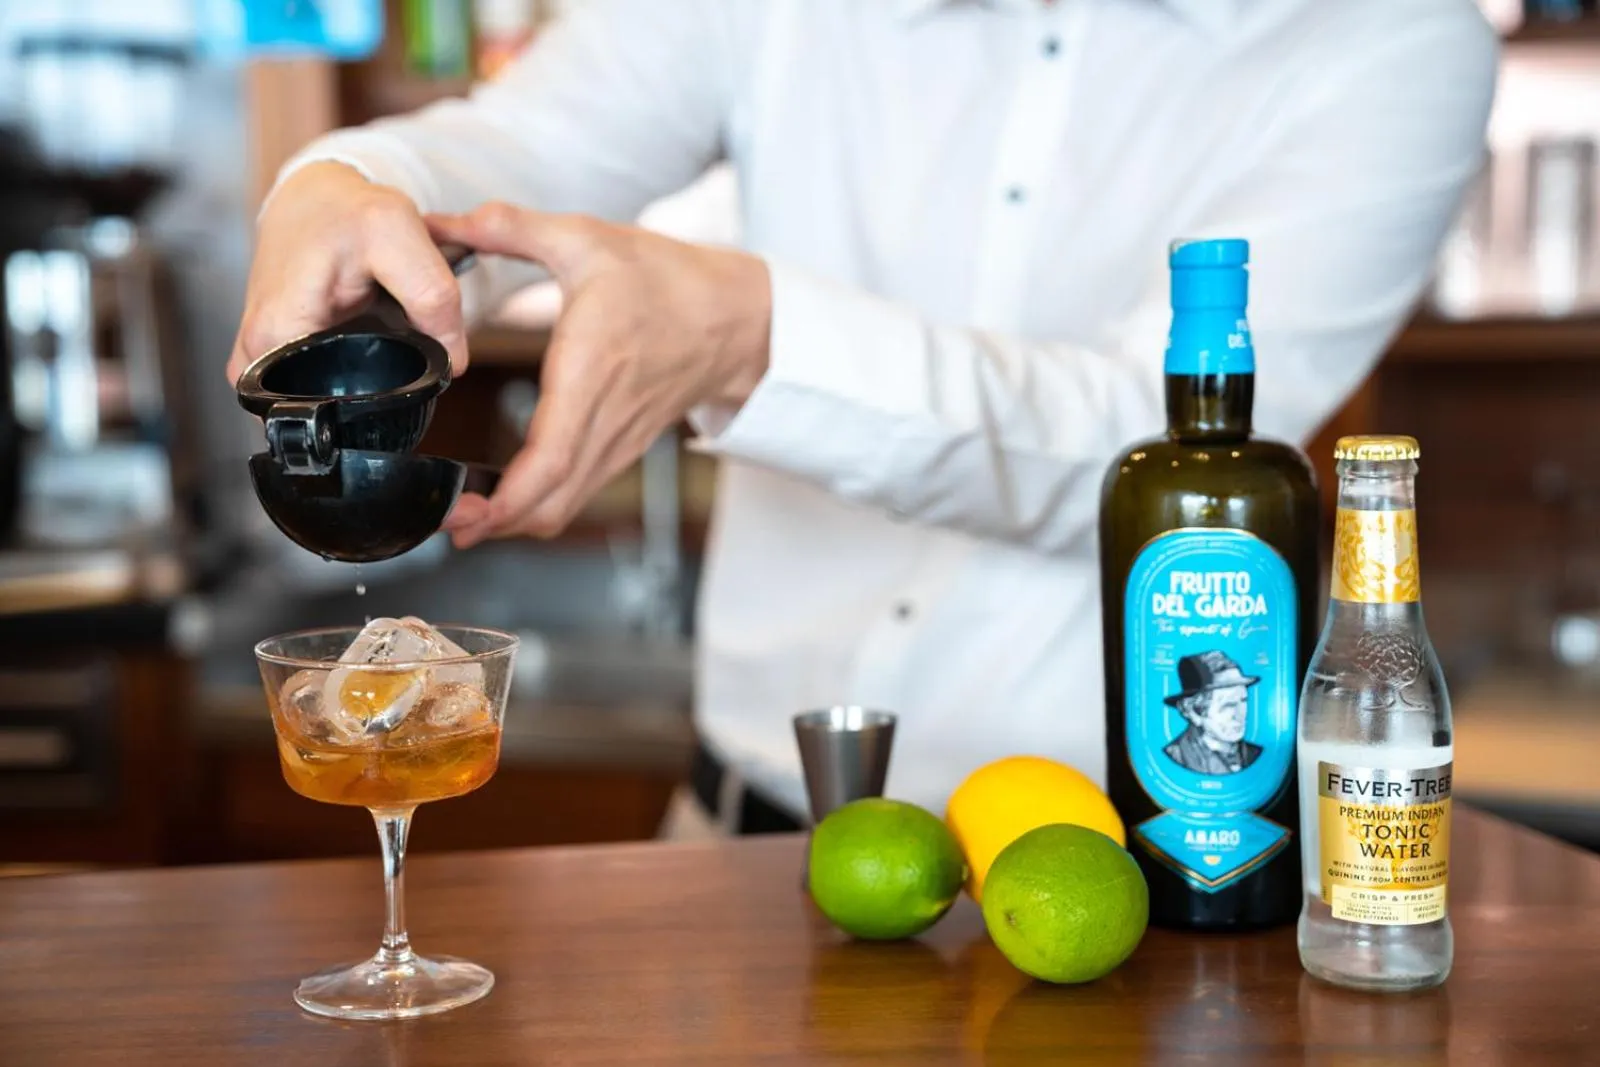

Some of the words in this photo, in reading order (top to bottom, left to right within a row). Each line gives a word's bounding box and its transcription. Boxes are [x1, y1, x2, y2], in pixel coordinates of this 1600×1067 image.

[1170, 571, 1250, 595] FRUTTO
[1152, 593, 1191, 618] DEL
[1195, 593, 1268, 618] GARDA
[1340, 806, 1404, 821] PREMIUM
[1408, 806, 1445, 821] INDIAN
[1184, 829, 1240, 846] AMARO
[1362, 823, 1430, 840] TONIC
[1359, 843, 1431, 859] WATER
[1328, 868, 1365, 881] QUININE
[1394, 874, 1430, 884] CENTRAL
[1353, 864, 1389, 873] NATURAL
[1351, 892, 1387, 901] CRISP
[1404, 892, 1434, 901] FRESH
